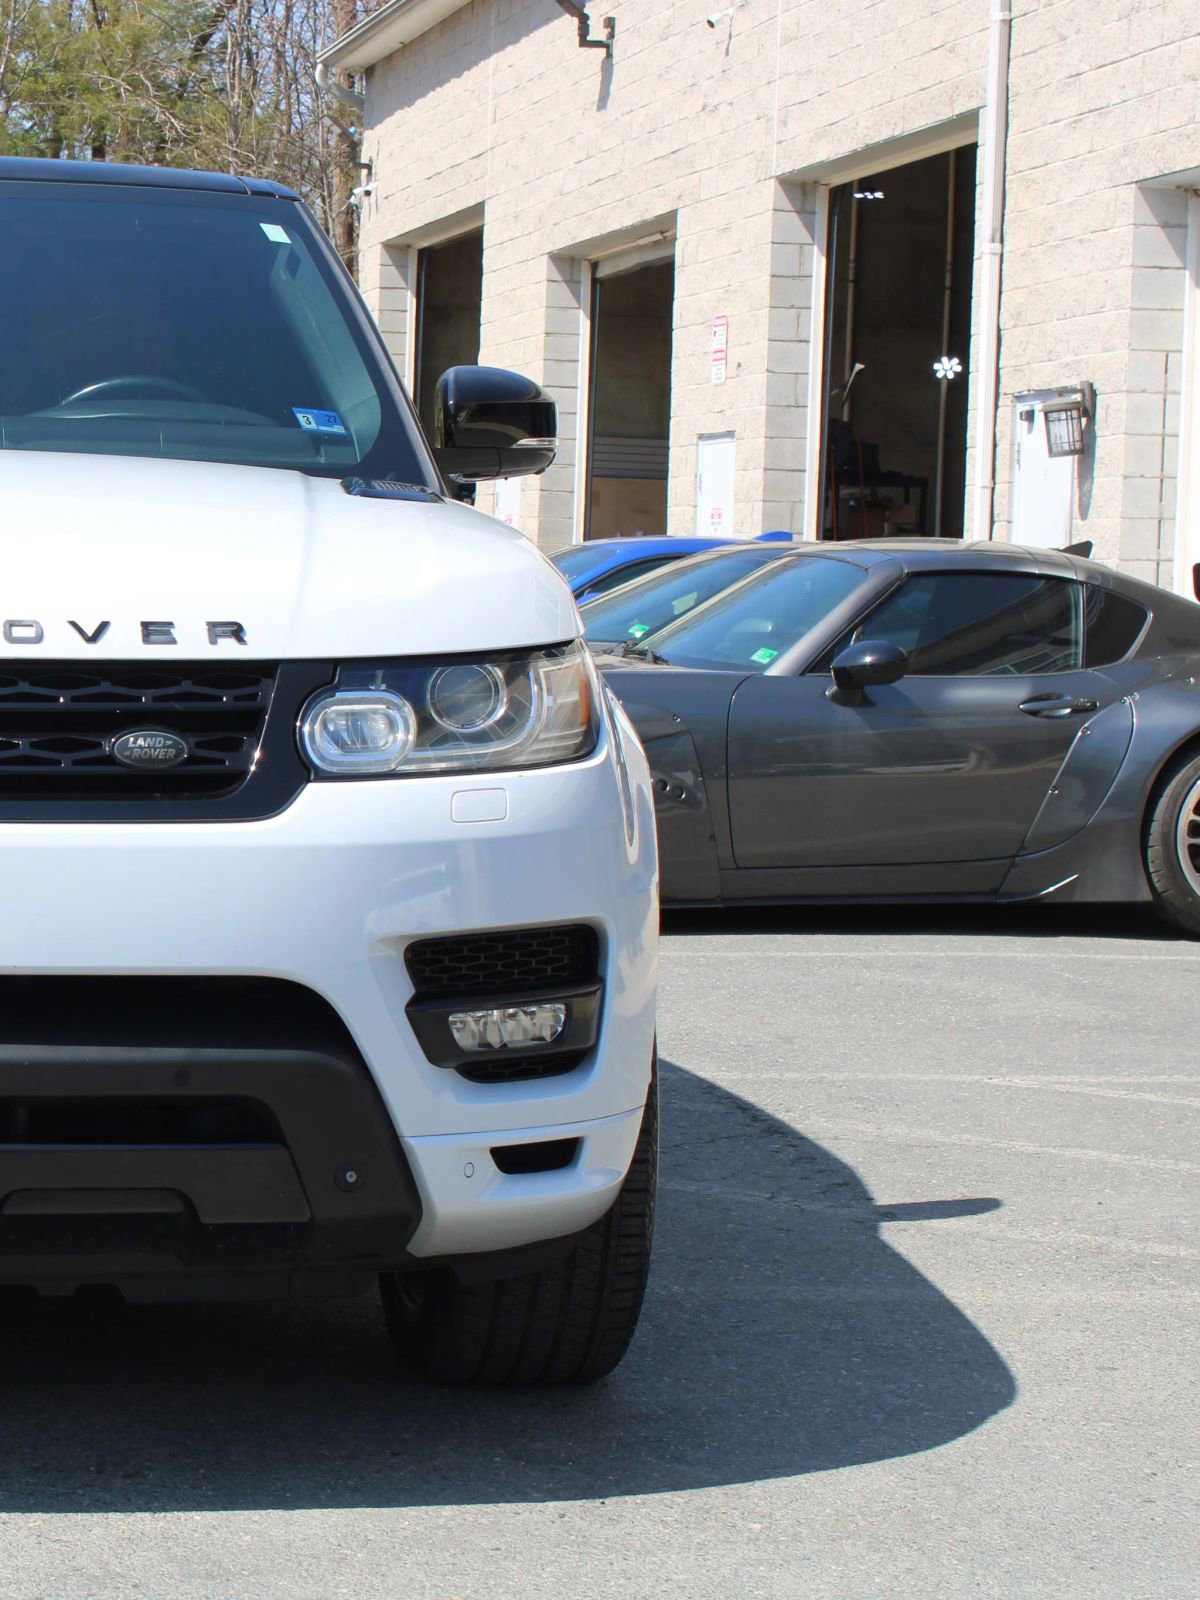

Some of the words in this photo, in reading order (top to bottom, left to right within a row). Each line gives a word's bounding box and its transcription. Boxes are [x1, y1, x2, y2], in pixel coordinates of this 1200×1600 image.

[302, 415, 312, 425] 3
[128, 737, 165, 748] LAND
[131, 748, 176, 760] ROVER
